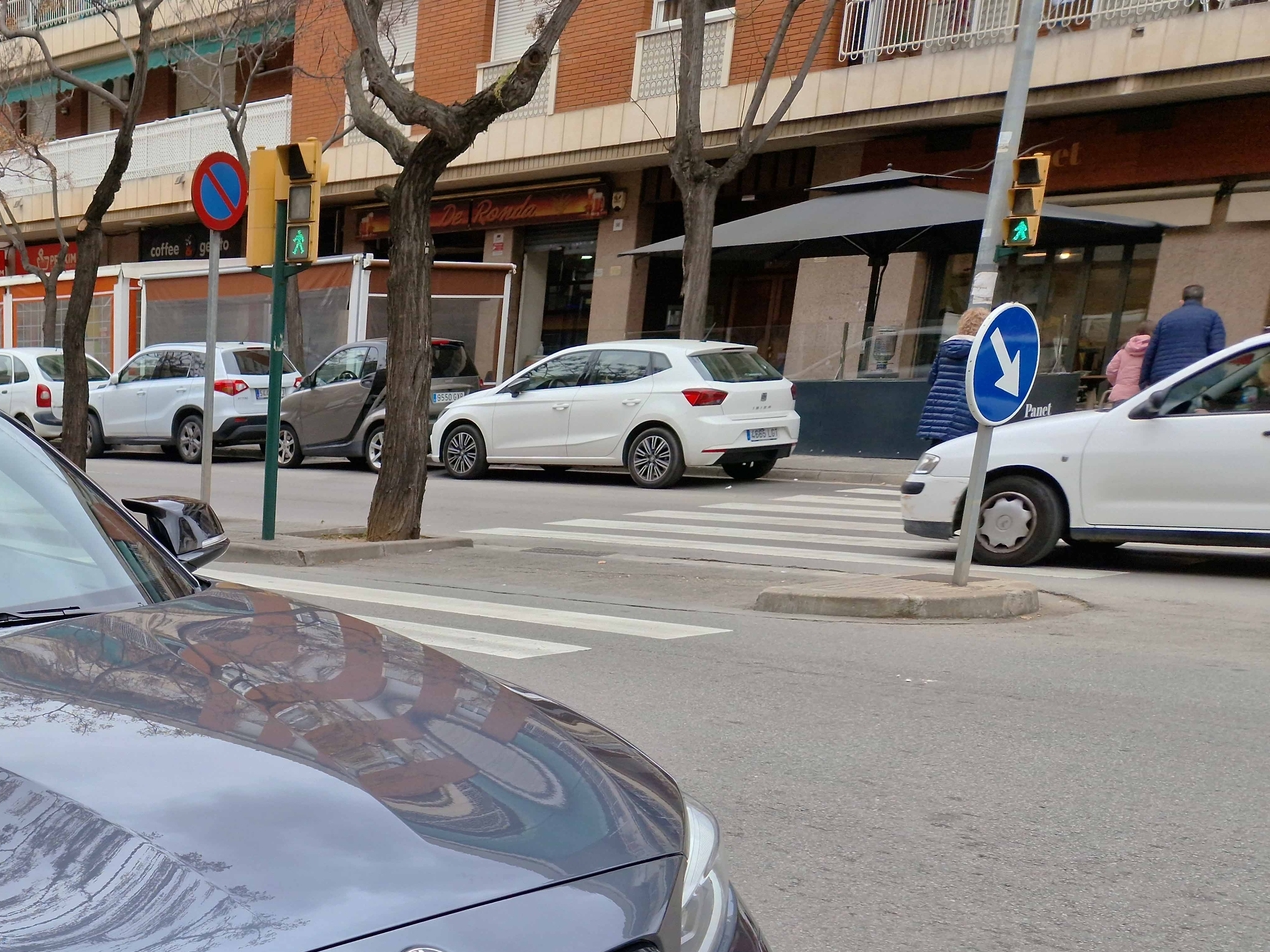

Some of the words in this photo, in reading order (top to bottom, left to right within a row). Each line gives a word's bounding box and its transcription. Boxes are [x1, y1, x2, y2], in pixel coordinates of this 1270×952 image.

[440, 203, 463, 227] De
[471, 195, 537, 225] Ronda
[150, 242, 180, 257] coffee
[199, 237, 230, 257] geto
[1024, 402, 1052, 418] Panet
